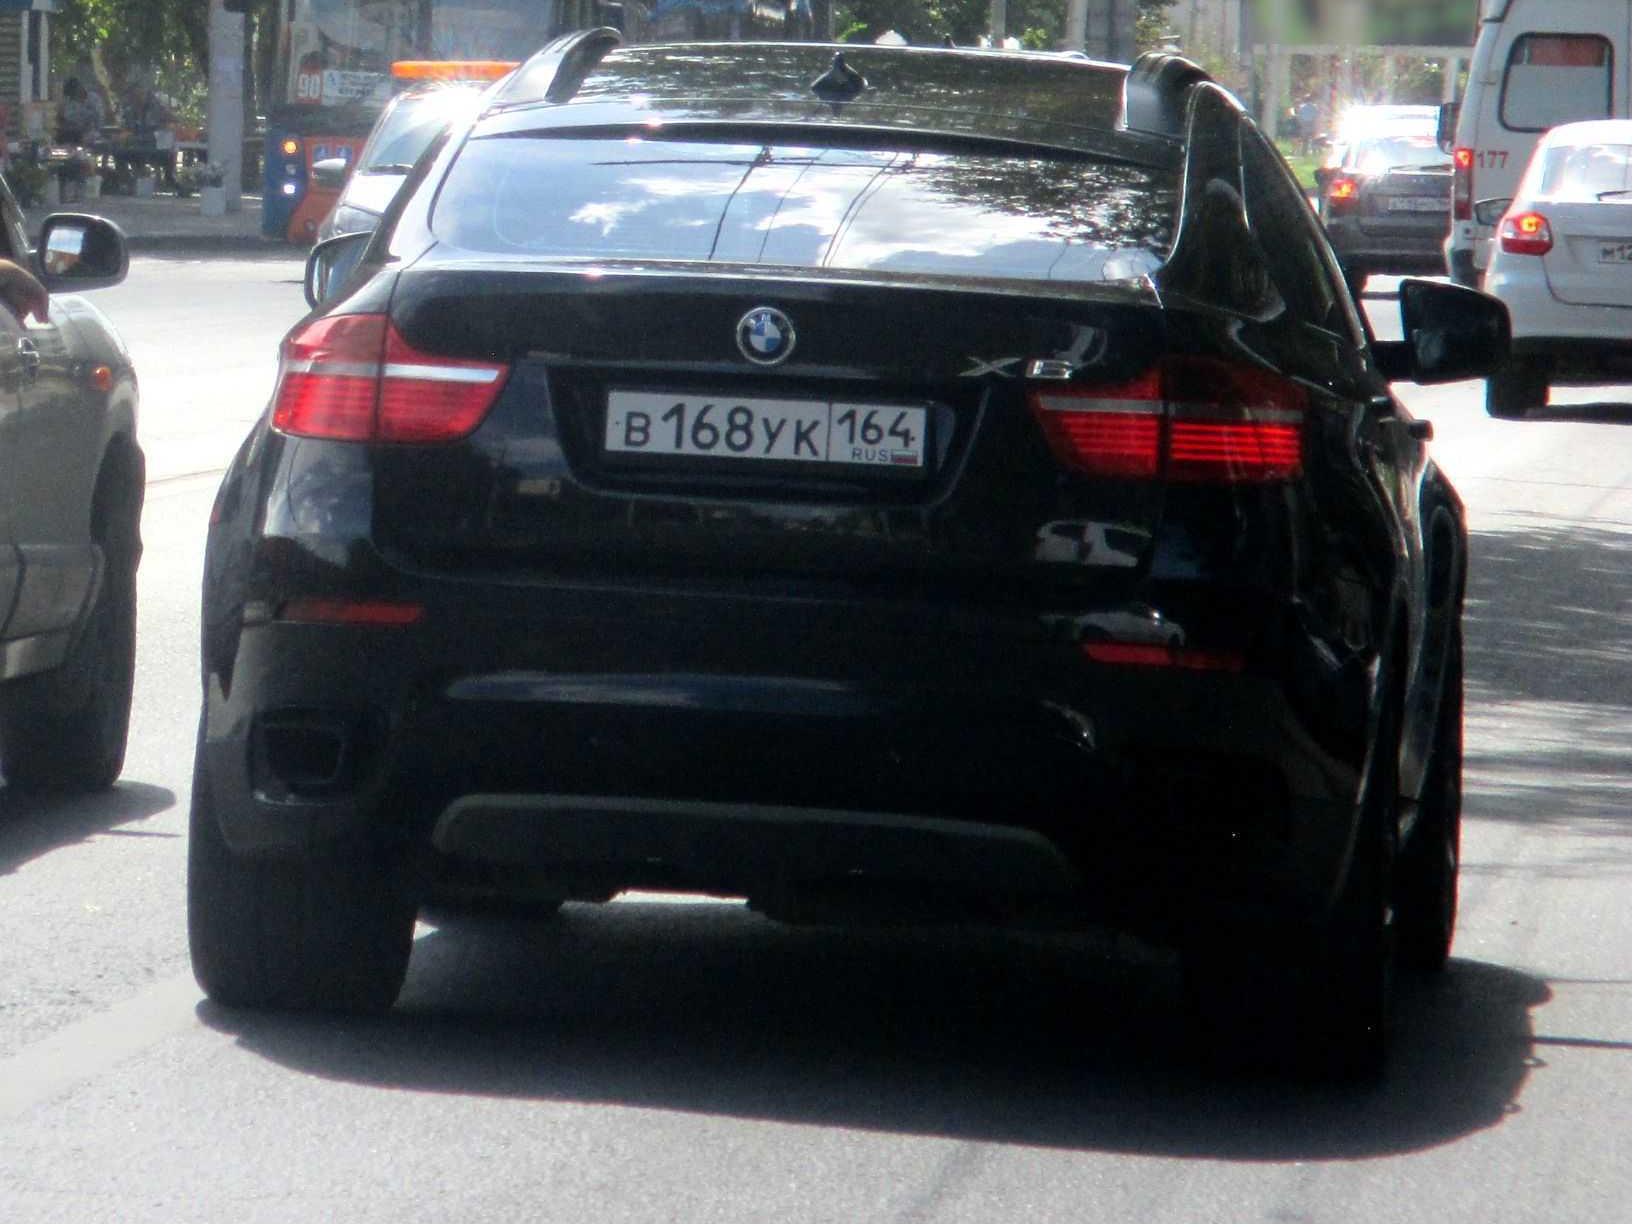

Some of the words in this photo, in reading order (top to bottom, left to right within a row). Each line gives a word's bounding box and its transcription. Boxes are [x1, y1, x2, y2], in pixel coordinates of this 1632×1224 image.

[1477, 151, 1509, 169] 177
[837, 409, 914, 448] 164
[852, 447, 890, 463] RUS
